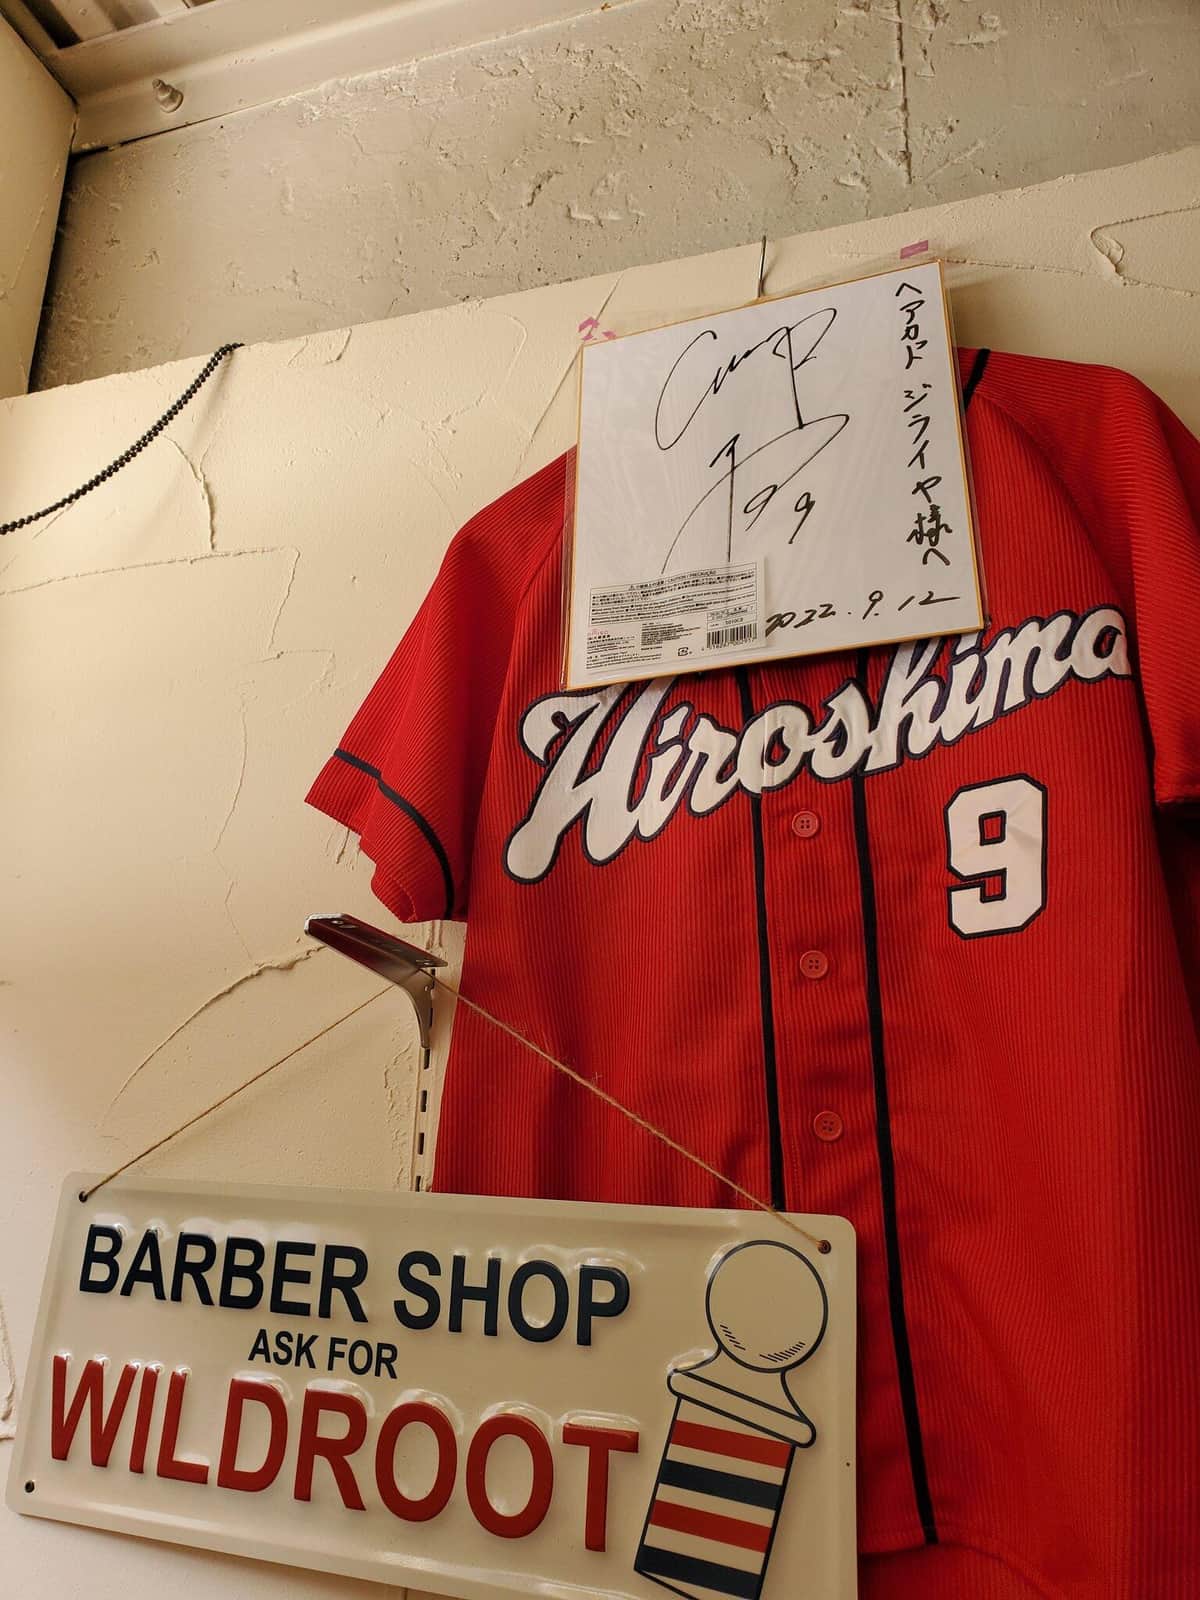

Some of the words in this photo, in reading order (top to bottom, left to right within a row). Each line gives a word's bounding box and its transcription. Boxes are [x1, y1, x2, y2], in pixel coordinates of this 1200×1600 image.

[503, 605, 1132, 884] Hiroshima
[946, 774, 1048, 939] 9
[79, 1223, 369, 1324] BARBER
[393, 1250, 631, 1347] SHOP
[247, 1328, 319, 1369] ASK
[326, 1336, 399, 1380] FOR
[51, 1355, 639, 1553] WILDROOT
